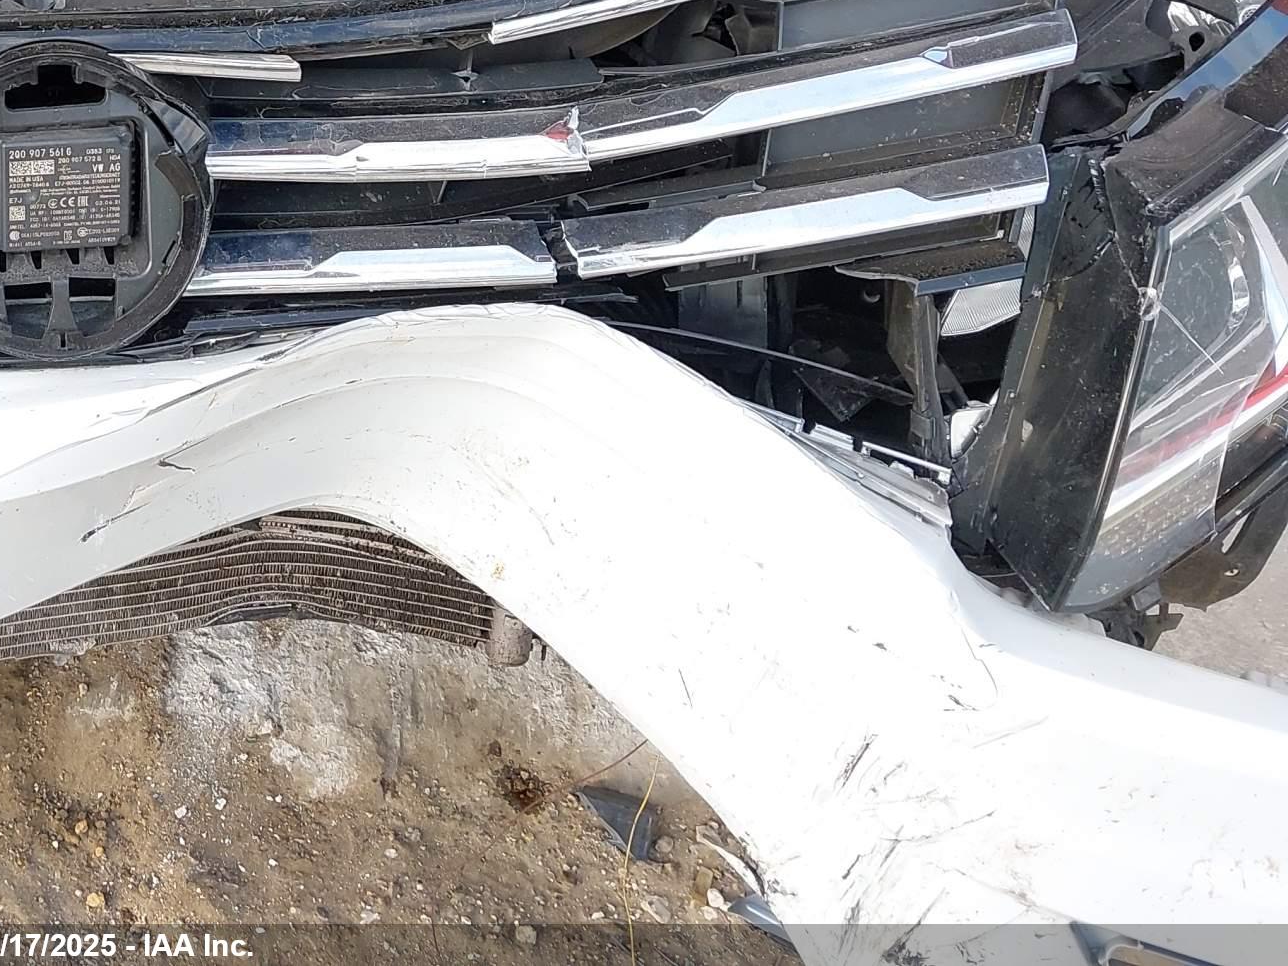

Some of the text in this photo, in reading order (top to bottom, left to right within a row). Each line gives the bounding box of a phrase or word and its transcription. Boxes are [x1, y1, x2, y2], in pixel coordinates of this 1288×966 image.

[29, 148, 46, 159] 907
[49, 147, 64, 157] 561
[66, 146, 72, 156] G
[92, 162, 121, 173] VW AG
